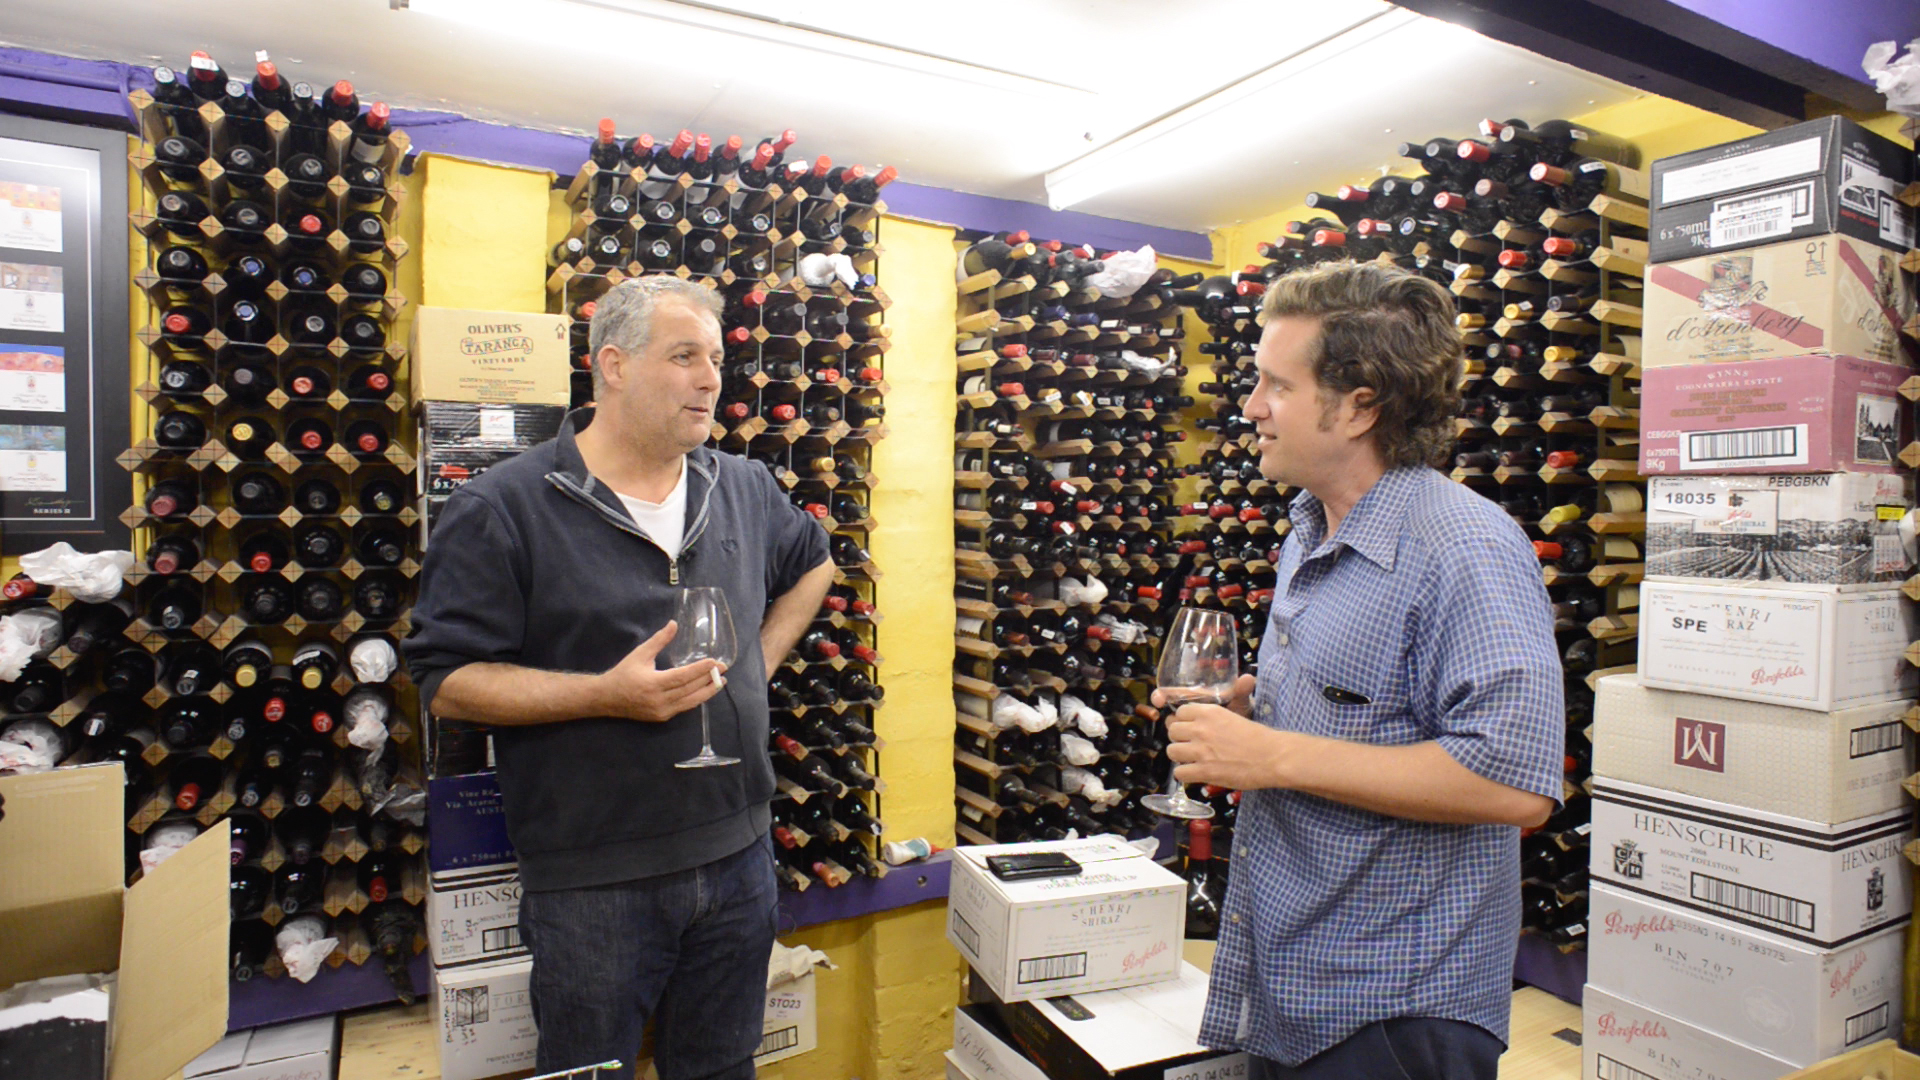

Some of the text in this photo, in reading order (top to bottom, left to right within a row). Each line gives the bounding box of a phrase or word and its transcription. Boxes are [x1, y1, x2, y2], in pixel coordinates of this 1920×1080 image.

[1659, 228, 1667, 240] 6
[1667, 230, 1674, 239] x
[467, 323, 522, 335] OLIVER'S
[464, 337, 530, 354] TARANGA
[471, 356, 526, 365] VINEYARDS
[1706, 368, 1749, 380] WYNNS
[1743, 376, 1783, 386] ESTATE
[1646, 458, 1666, 471] 9Kg
[432, 478, 441, 490] 6
[442, 480, 449, 489] x
[1768, 475, 1830, 487] PEBGBKN
[1665, 492, 1716, 505] 18035
[1672, 616, 1708, 633] SPE
[1751, 665, 1807, 686] Penfolds
[1633, 813, 1775, 862] HENSCHKE
[1659, 848, 1690, 861] MOUNT
[1089, 903, 1132, 916] HENRI
[1081, 914, 1121, 927] SHIRAZ
[1605, 910, 1676, 941] Penfolds
[1654, 942, 1734, 977] BIN 707
[1597, 1011, 1671, 1043] Penfolds
[1648, 1048, 1680, 1068] BIN
